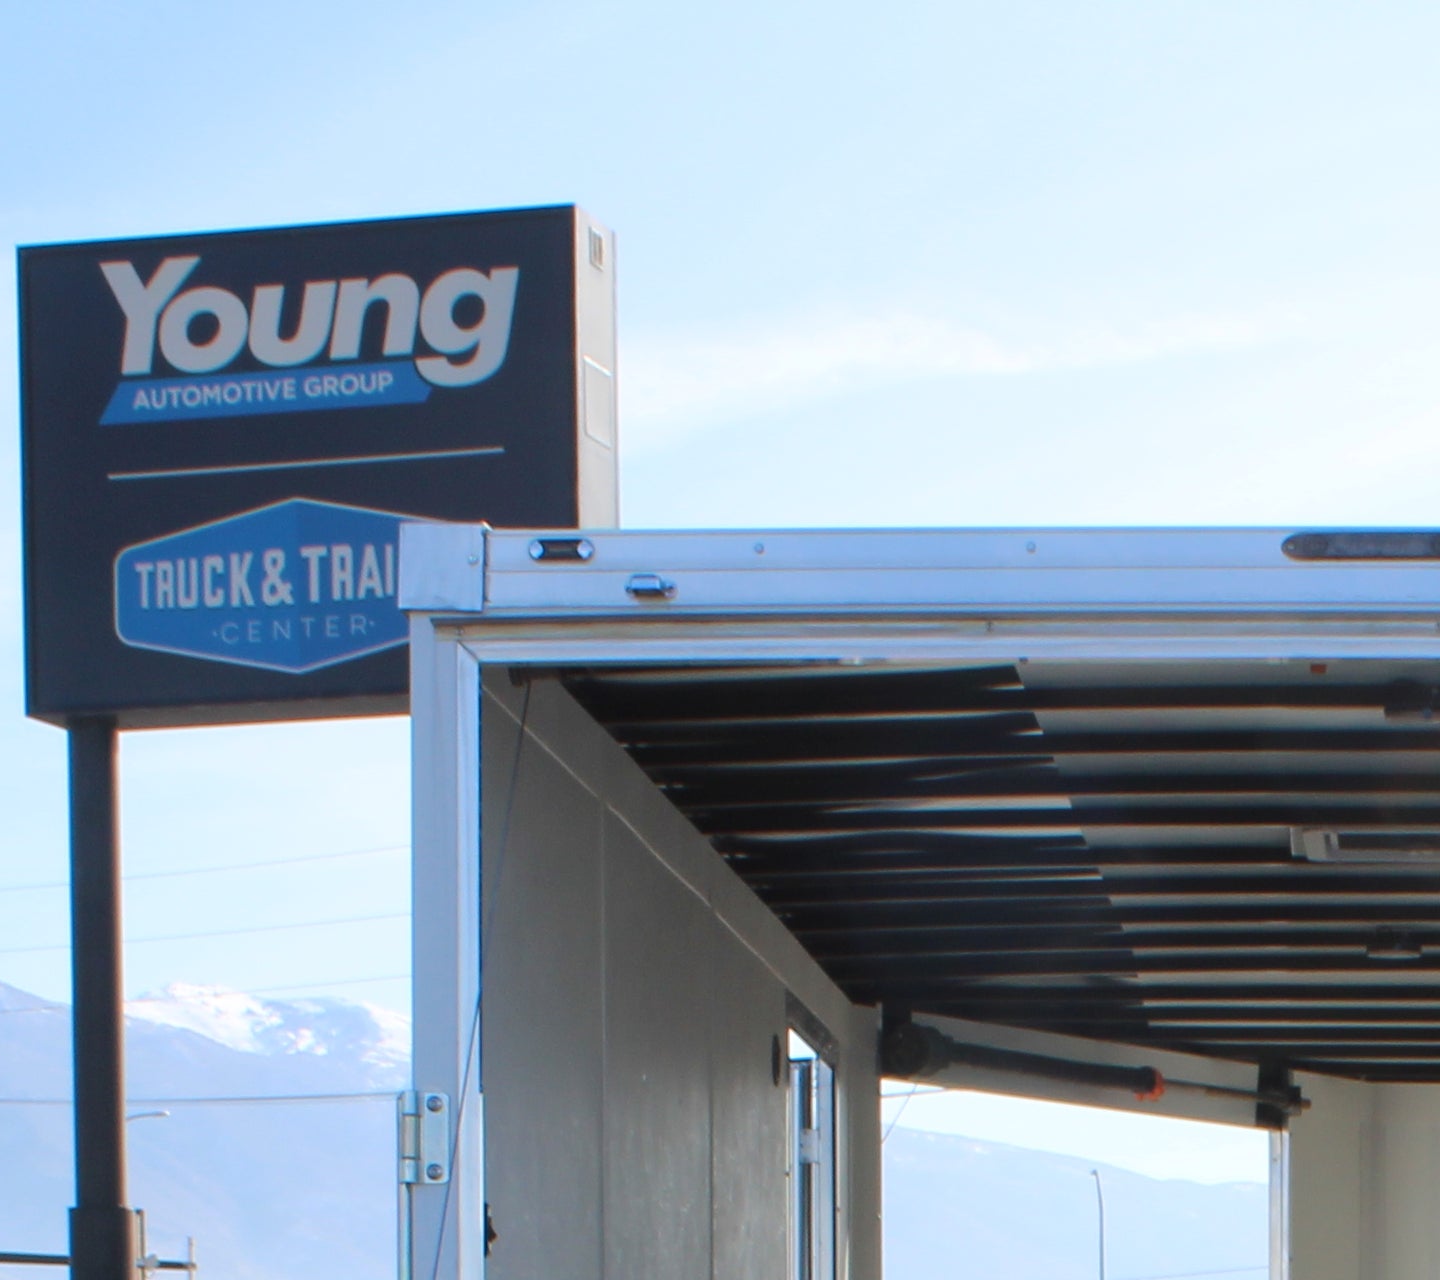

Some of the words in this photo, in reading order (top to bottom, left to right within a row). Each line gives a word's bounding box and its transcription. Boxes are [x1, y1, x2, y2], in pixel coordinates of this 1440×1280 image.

[99, 255, 520, 387] Young
[132, 379, 297, 410] AUTOMOTIVE
[303, 371, 394, 397] GROUP
[134, 552, 256, 610] TRUCK
[262, 548, 295, 606] &
[220, 614, 368, 645] CENTER
